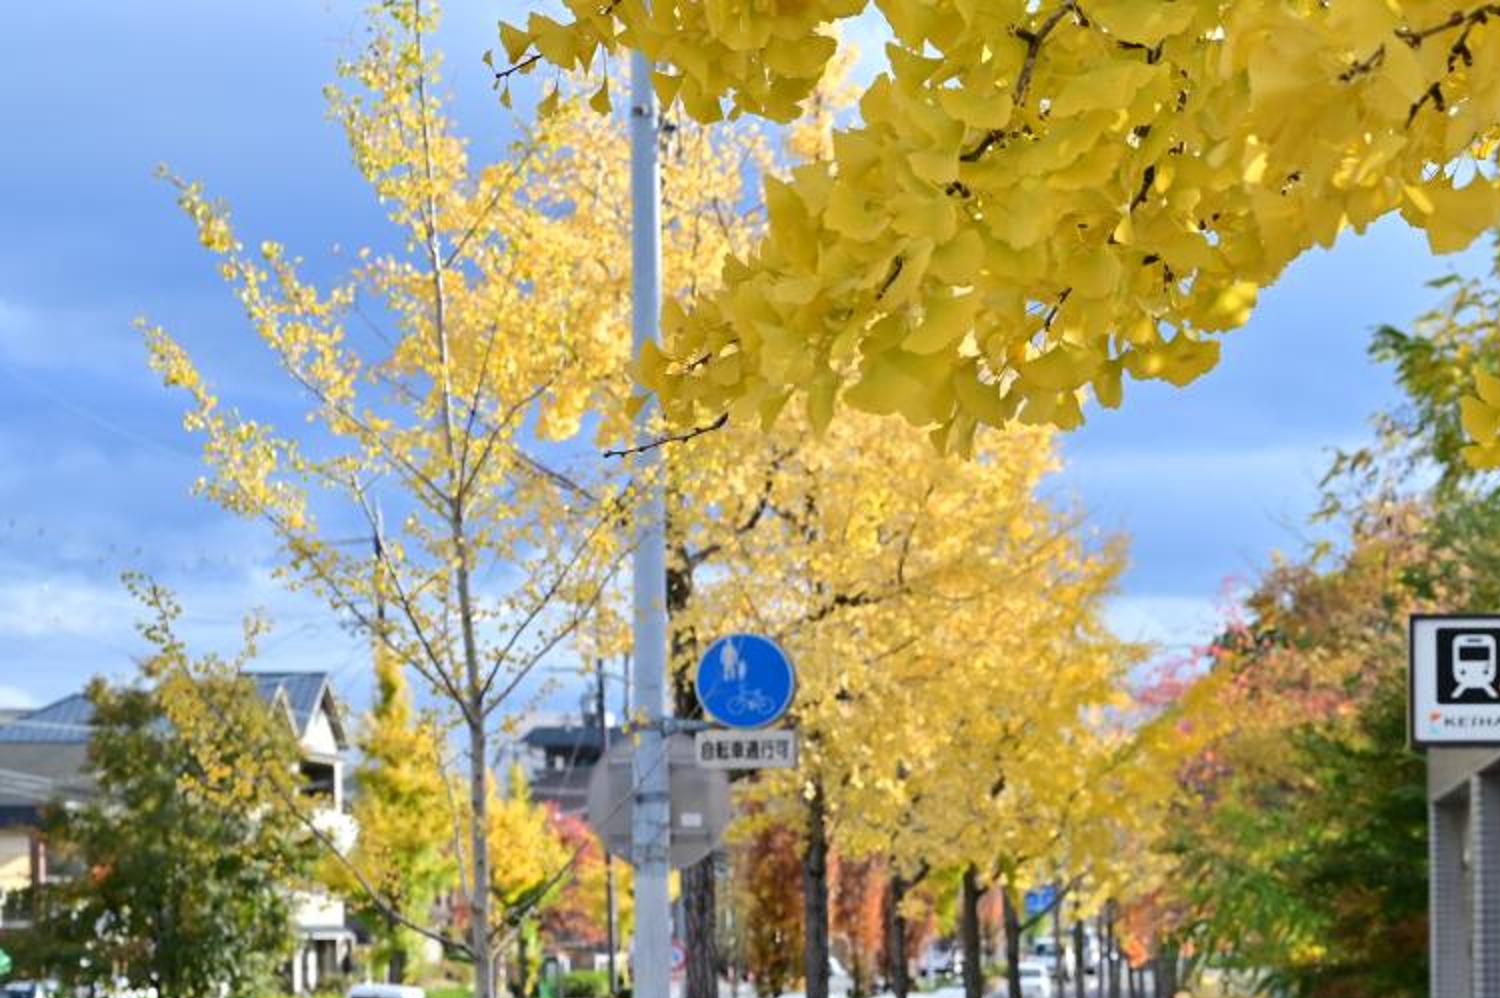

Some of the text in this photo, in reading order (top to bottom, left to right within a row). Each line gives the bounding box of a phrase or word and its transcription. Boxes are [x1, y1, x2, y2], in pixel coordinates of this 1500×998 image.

[702, 740, 789, 761] 自転車通行可
